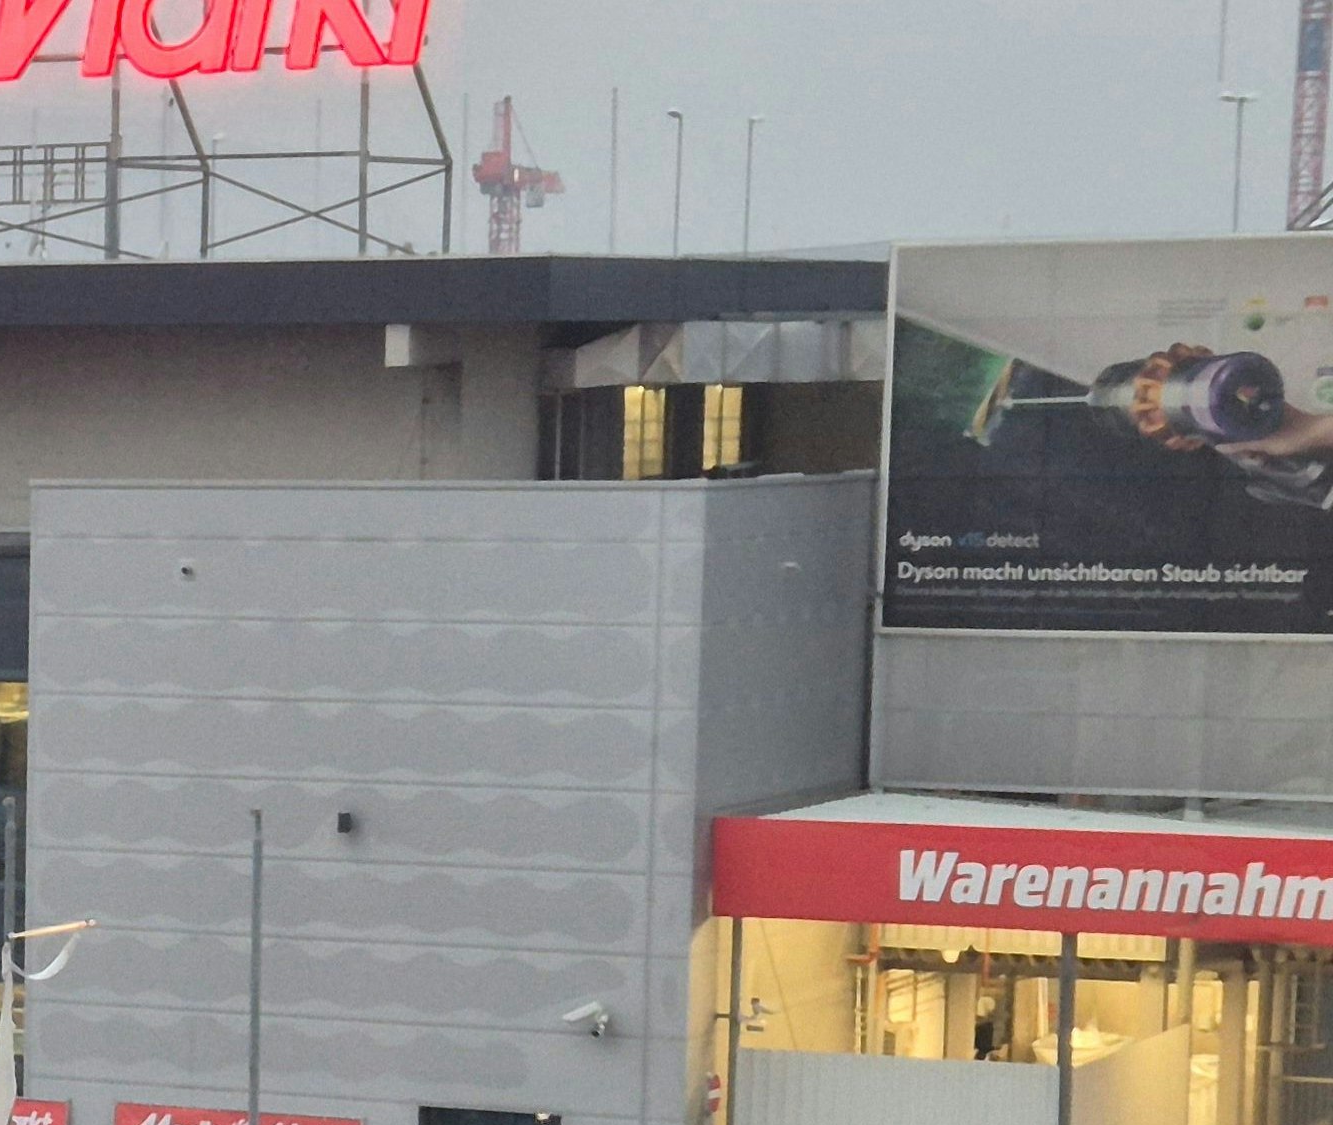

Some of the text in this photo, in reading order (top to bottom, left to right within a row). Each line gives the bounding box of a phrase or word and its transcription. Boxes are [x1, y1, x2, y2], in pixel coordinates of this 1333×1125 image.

[899, 530, 952, 551] dyson
[986, 532, 1039, 548] detect
[897, 561, 1308, 583] Dyson macht unsichtbaren Staub sichtbar
[898, 849, 1333, 921] Warenannahm
